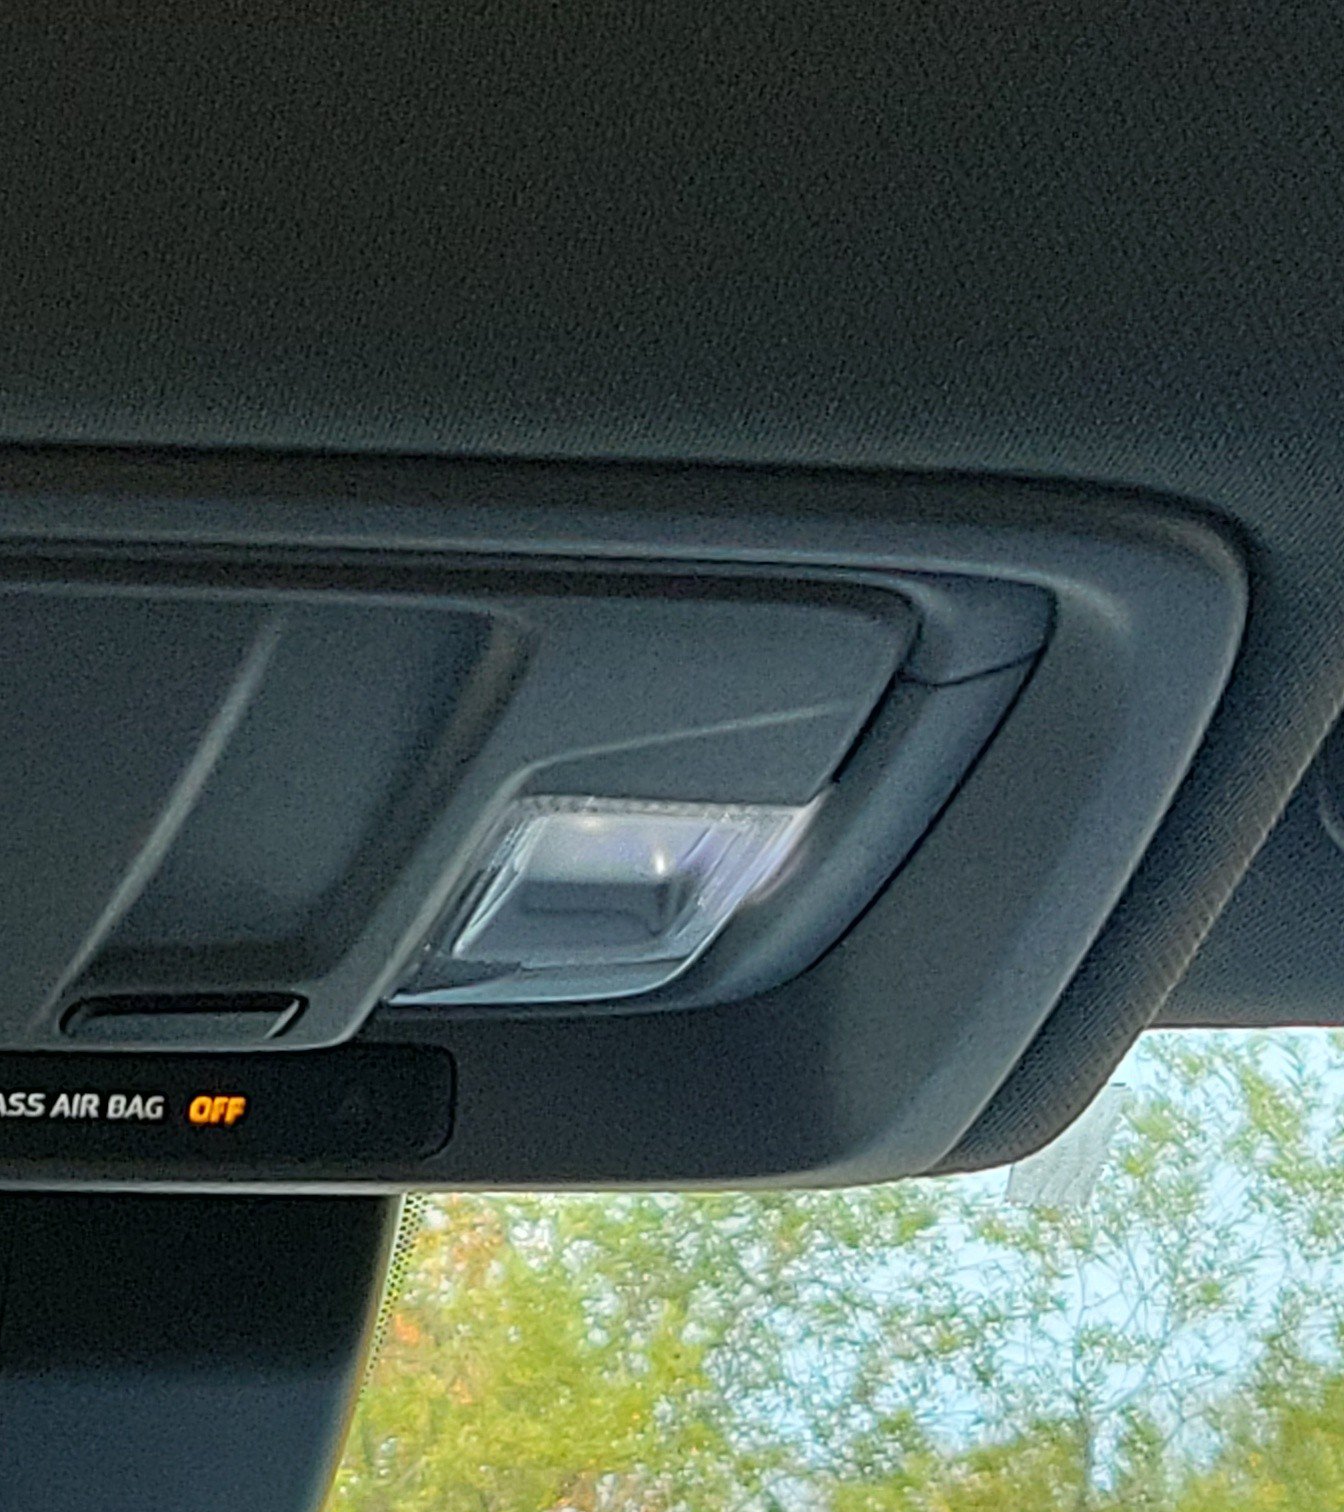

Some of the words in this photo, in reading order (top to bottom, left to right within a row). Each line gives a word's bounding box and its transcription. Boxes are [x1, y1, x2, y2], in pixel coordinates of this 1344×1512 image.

[49, 1093, 100, 1119] AIR
[106, 1094, 165, 1120] BAG
[188, 1096, 246, 1125] OFF
